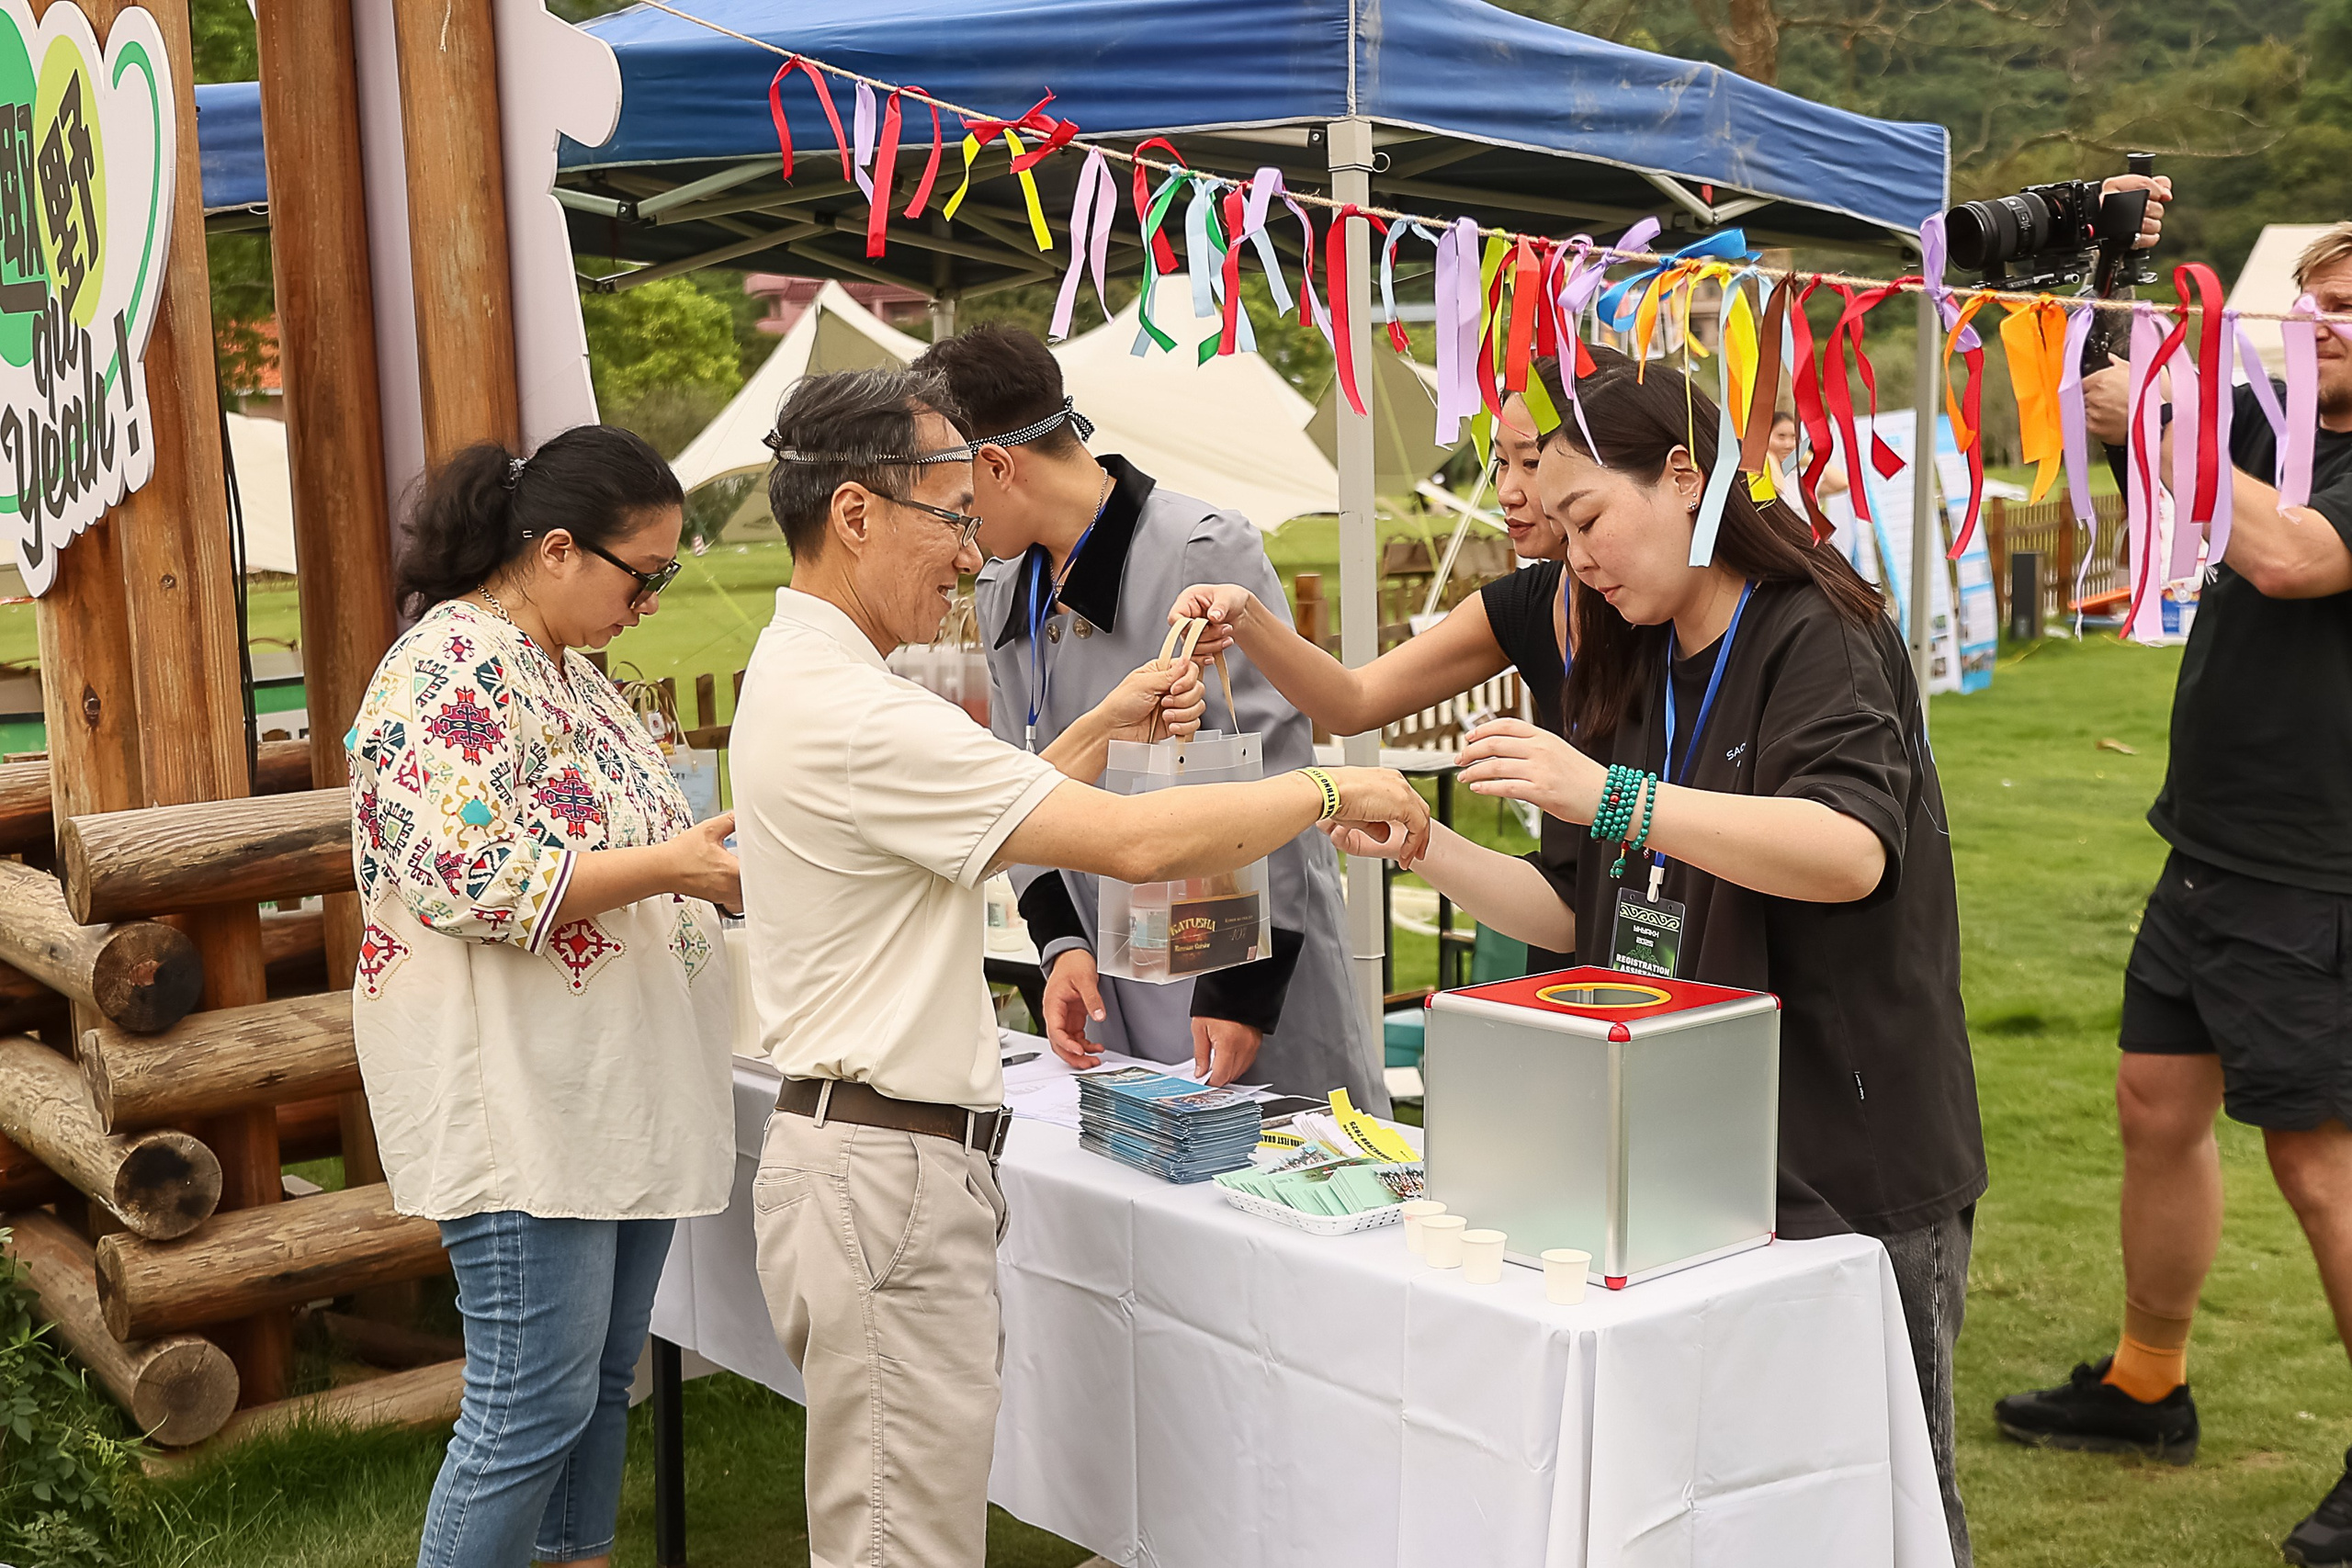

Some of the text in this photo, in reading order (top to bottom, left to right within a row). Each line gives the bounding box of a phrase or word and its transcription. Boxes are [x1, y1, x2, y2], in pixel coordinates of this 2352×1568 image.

[1, 309, 140, 570] yeah!
[1321, 779, 1336, 803] ETHNO
[1170, 918, 1216, 936] KATUSHA
[1616, 953, 1669, 976] REGISTRATION
[1349, 1121, 1364, 1138] 2025
[1277, 1135, 1290, 1145] FEST
